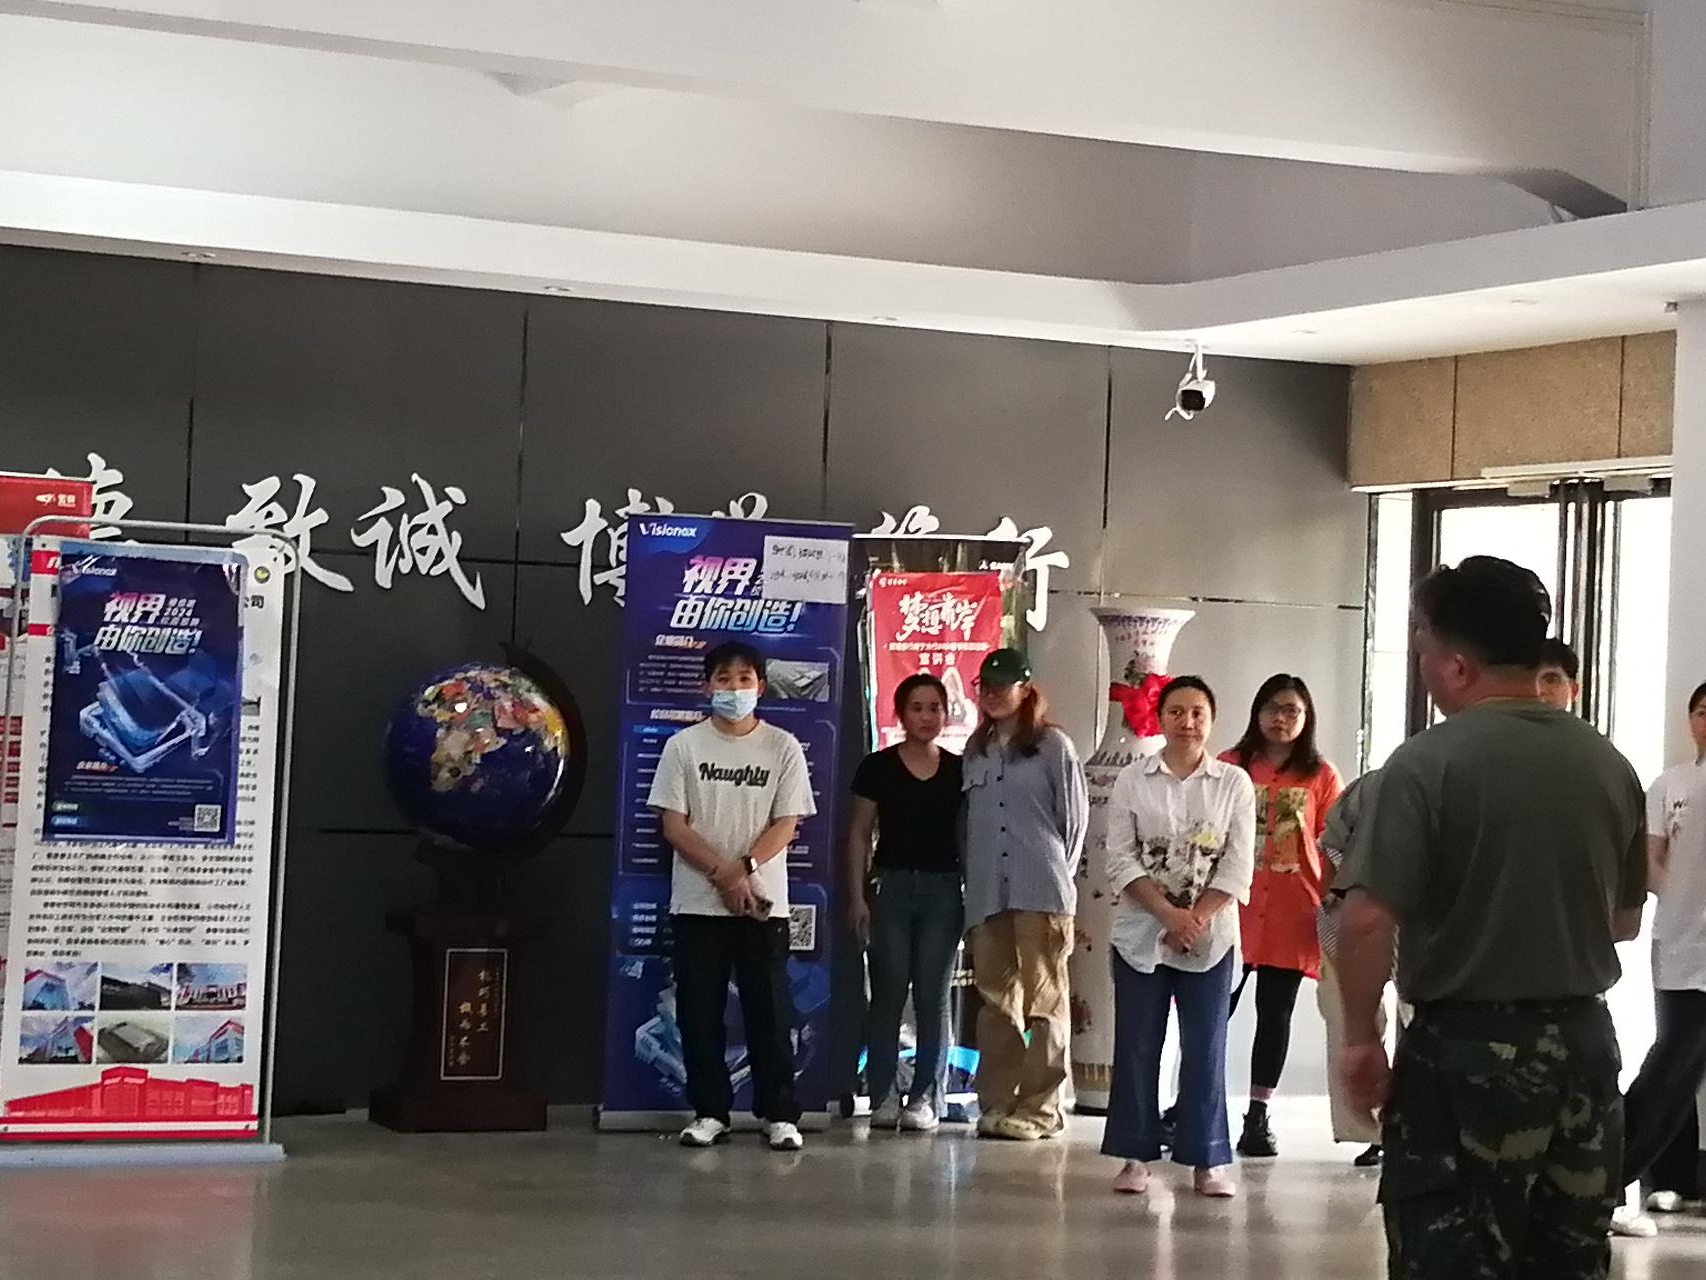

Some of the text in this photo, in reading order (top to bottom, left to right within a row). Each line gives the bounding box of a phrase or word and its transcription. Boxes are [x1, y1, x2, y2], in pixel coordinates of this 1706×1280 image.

[639, 522, 698, 538] Visionox
[682, 555, 757, 596] 视界
[103, 592, 167, 625] 视界
[669, 597, 803, 634] 由你创造!
[699, 762, 770, 787] Naughty
